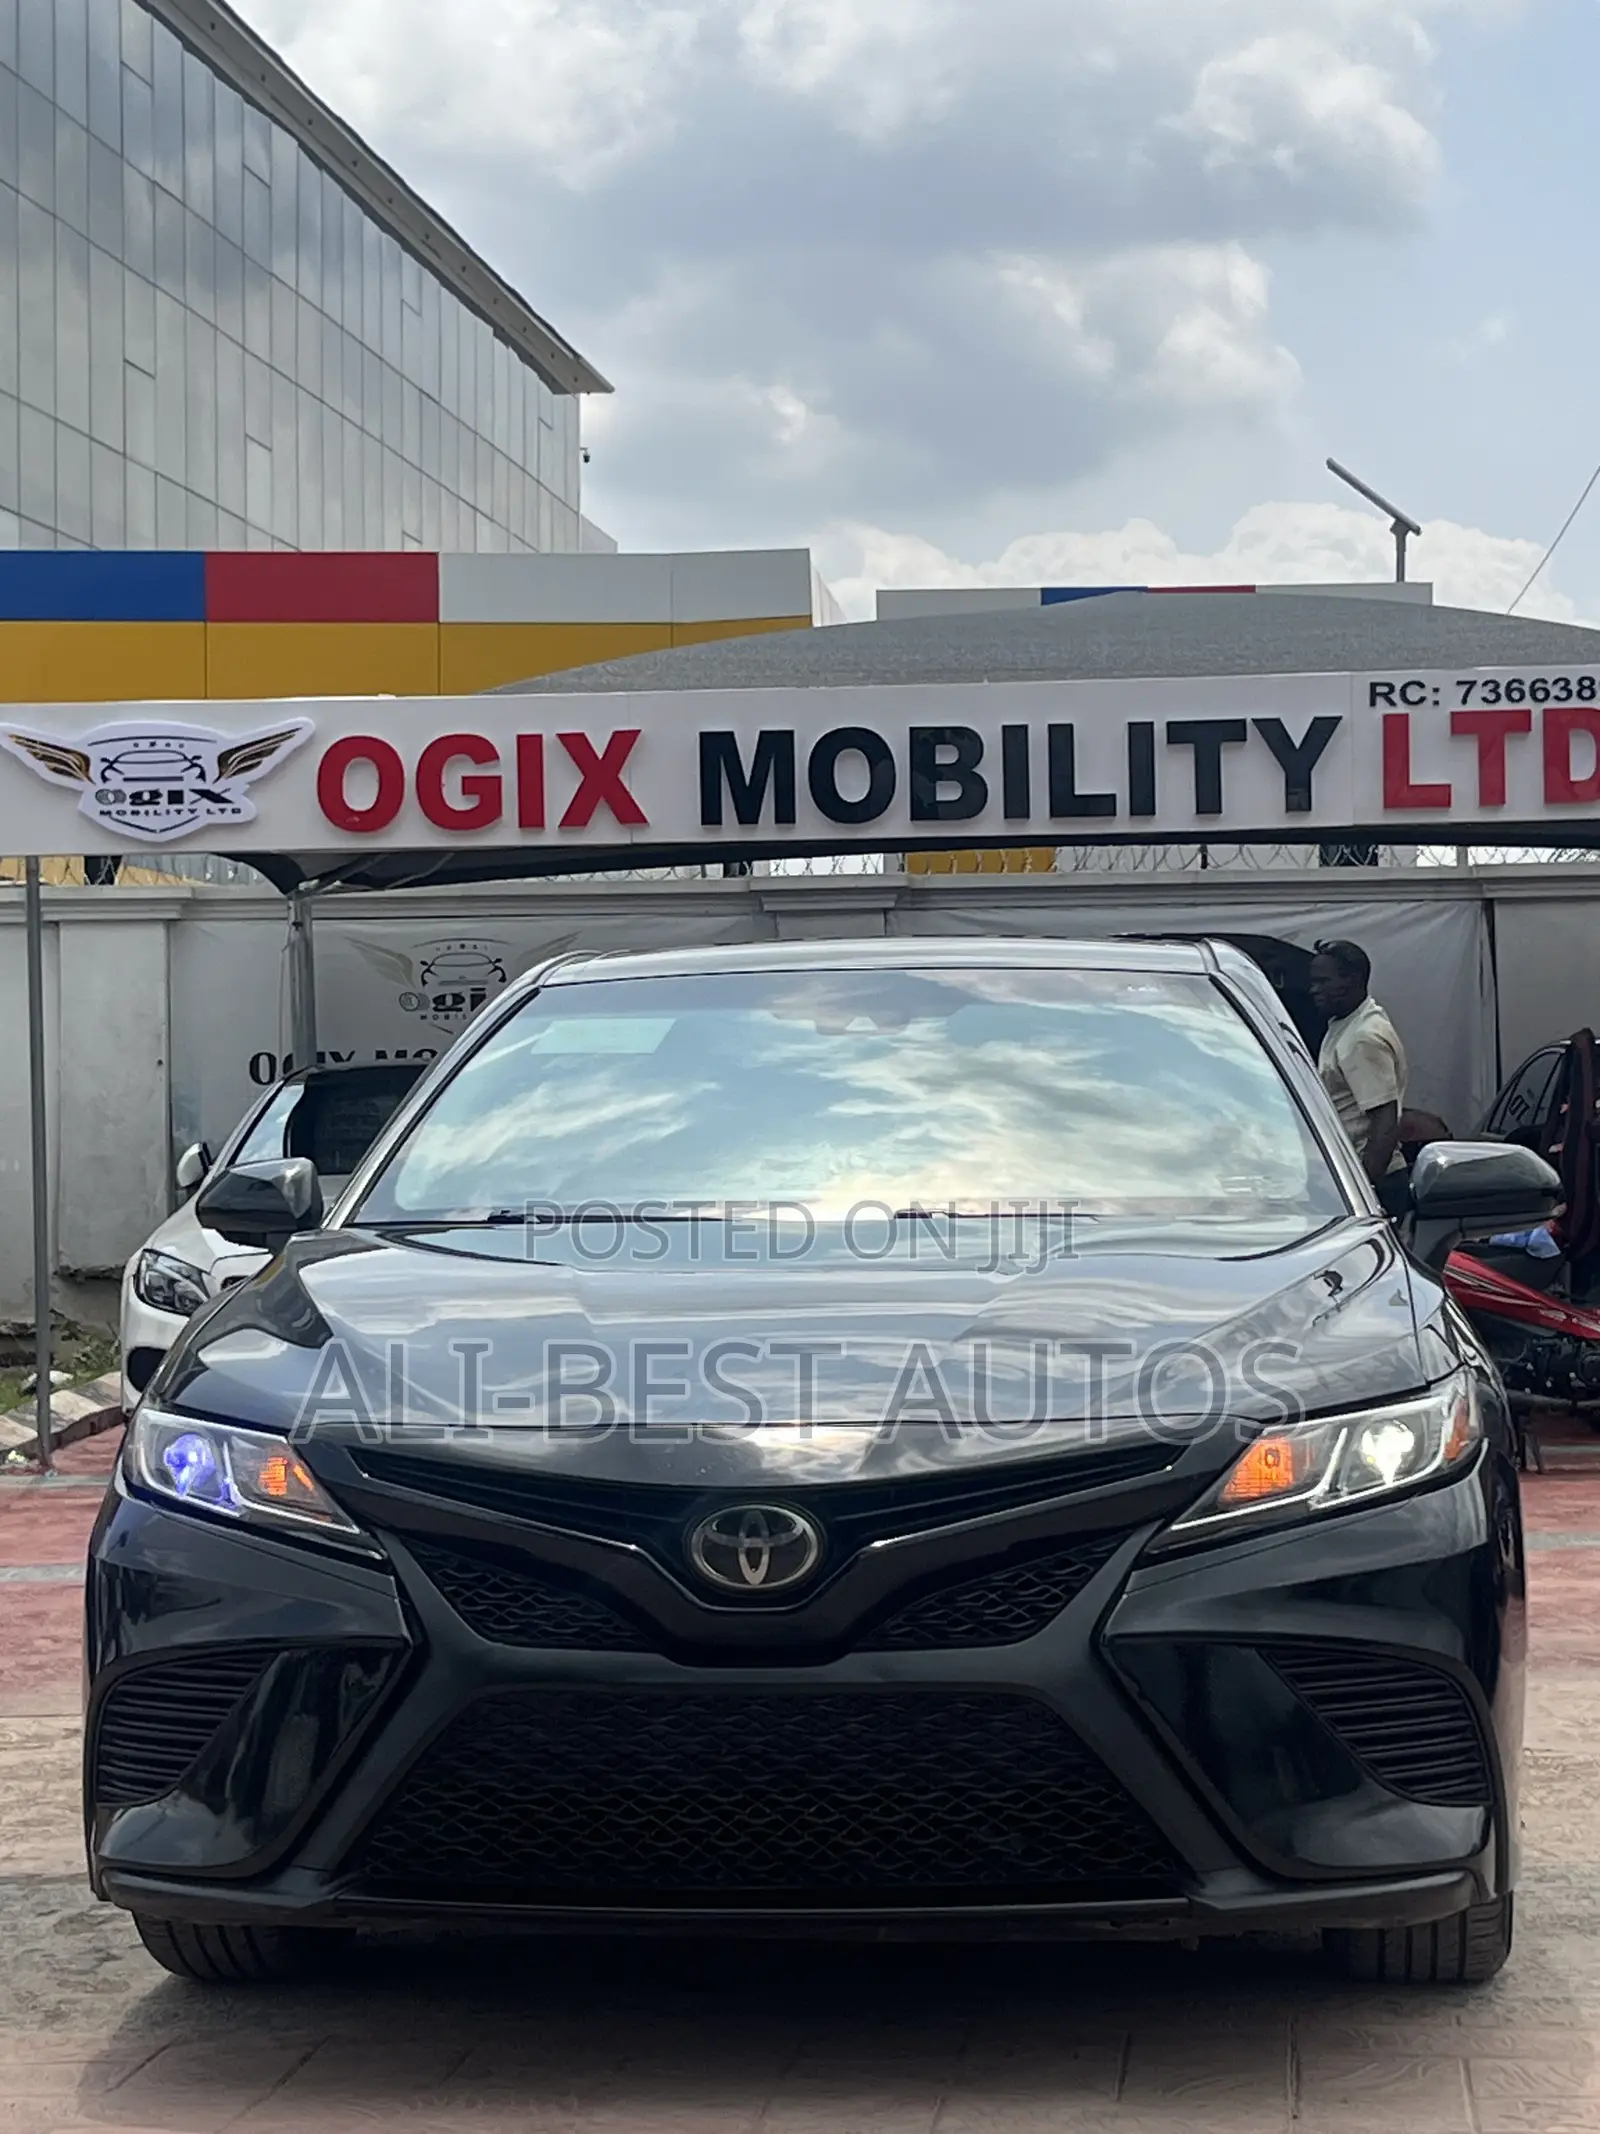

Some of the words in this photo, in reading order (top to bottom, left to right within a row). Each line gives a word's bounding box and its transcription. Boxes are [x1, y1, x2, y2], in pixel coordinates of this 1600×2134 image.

[1368, 680, 1440, 707] RC:
[1455, 675, 1600, 706] 736638
[317, 729, 649, 833] OGIX
[699, 715, 1343, 827] MOBILITY
[1382, 707, 1600, 809] LTD
[99, 808, 198, 816] MOBILITY
